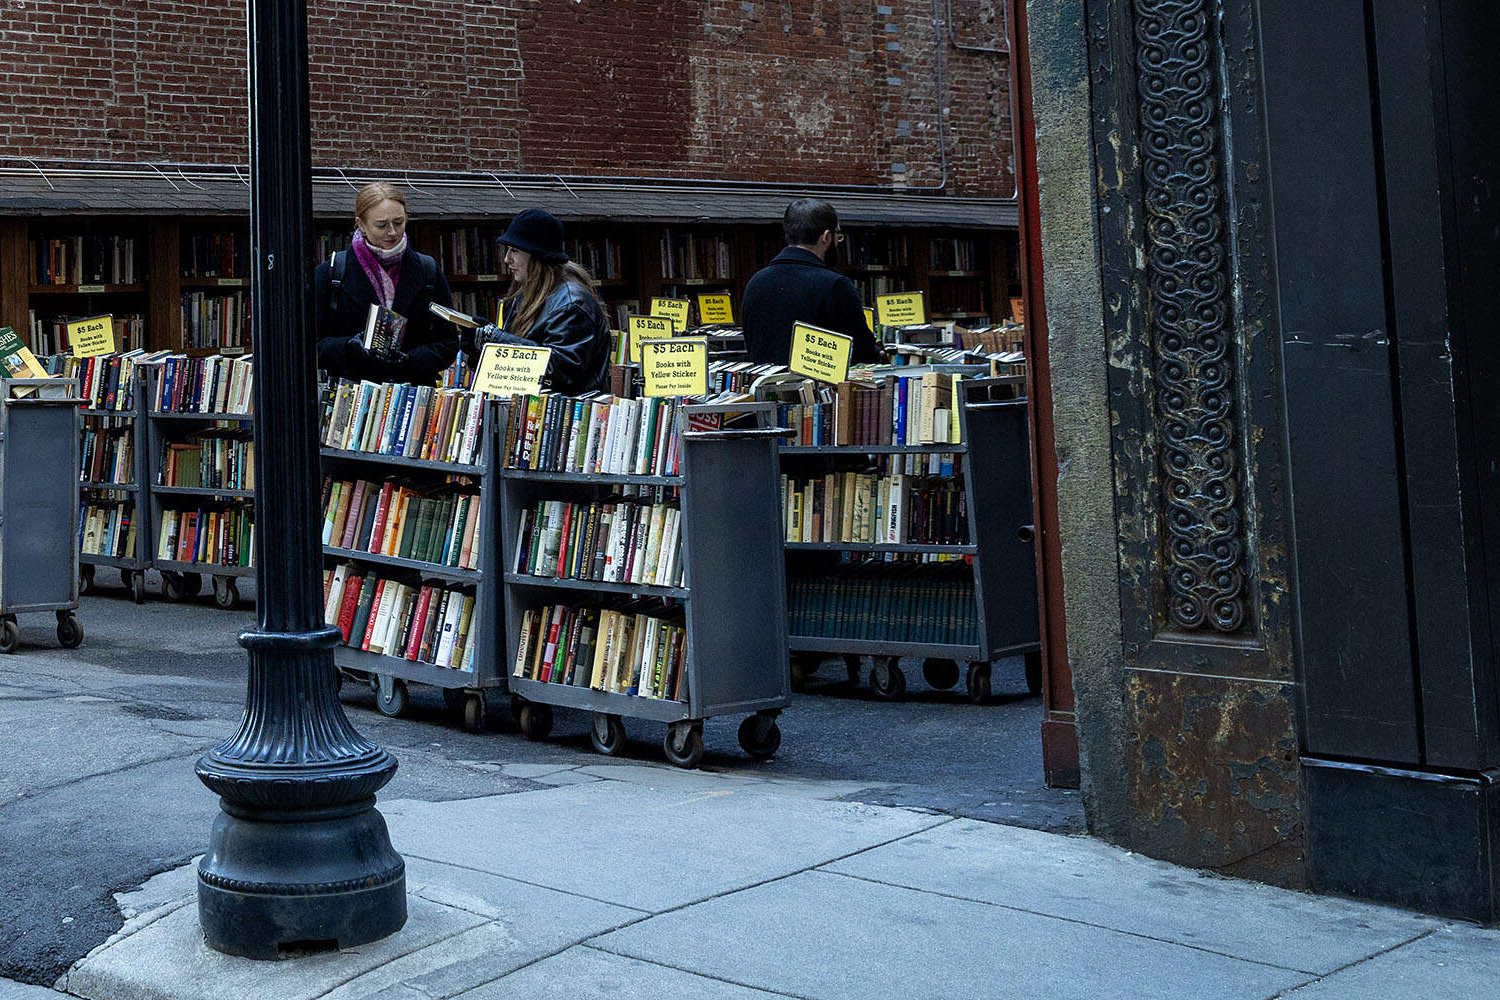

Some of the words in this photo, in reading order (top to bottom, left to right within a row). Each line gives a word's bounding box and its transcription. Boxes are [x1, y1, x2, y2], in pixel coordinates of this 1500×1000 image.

[658, 300, 666, 308] $5
[77, 326, 86, 334] $5
[87, 323, 104, 332] Each
[636, 319, 646, 329] $5
[648, 320, 666, 330] Each
[805, 333, 816, 344] $5
[818, 337, 838, 350] Each
[653, 343, 666, 354] $5
[669, 342, 694, 353] Each
[495, 348, 509, 358] $5
[512, 350, 538, 360] Each
[494, 364, 514, 372] Books
[676, 360, 692, 368] with
[487, 372, 508, 380] Yellow
[672, 370, 697, 378] Sticker
